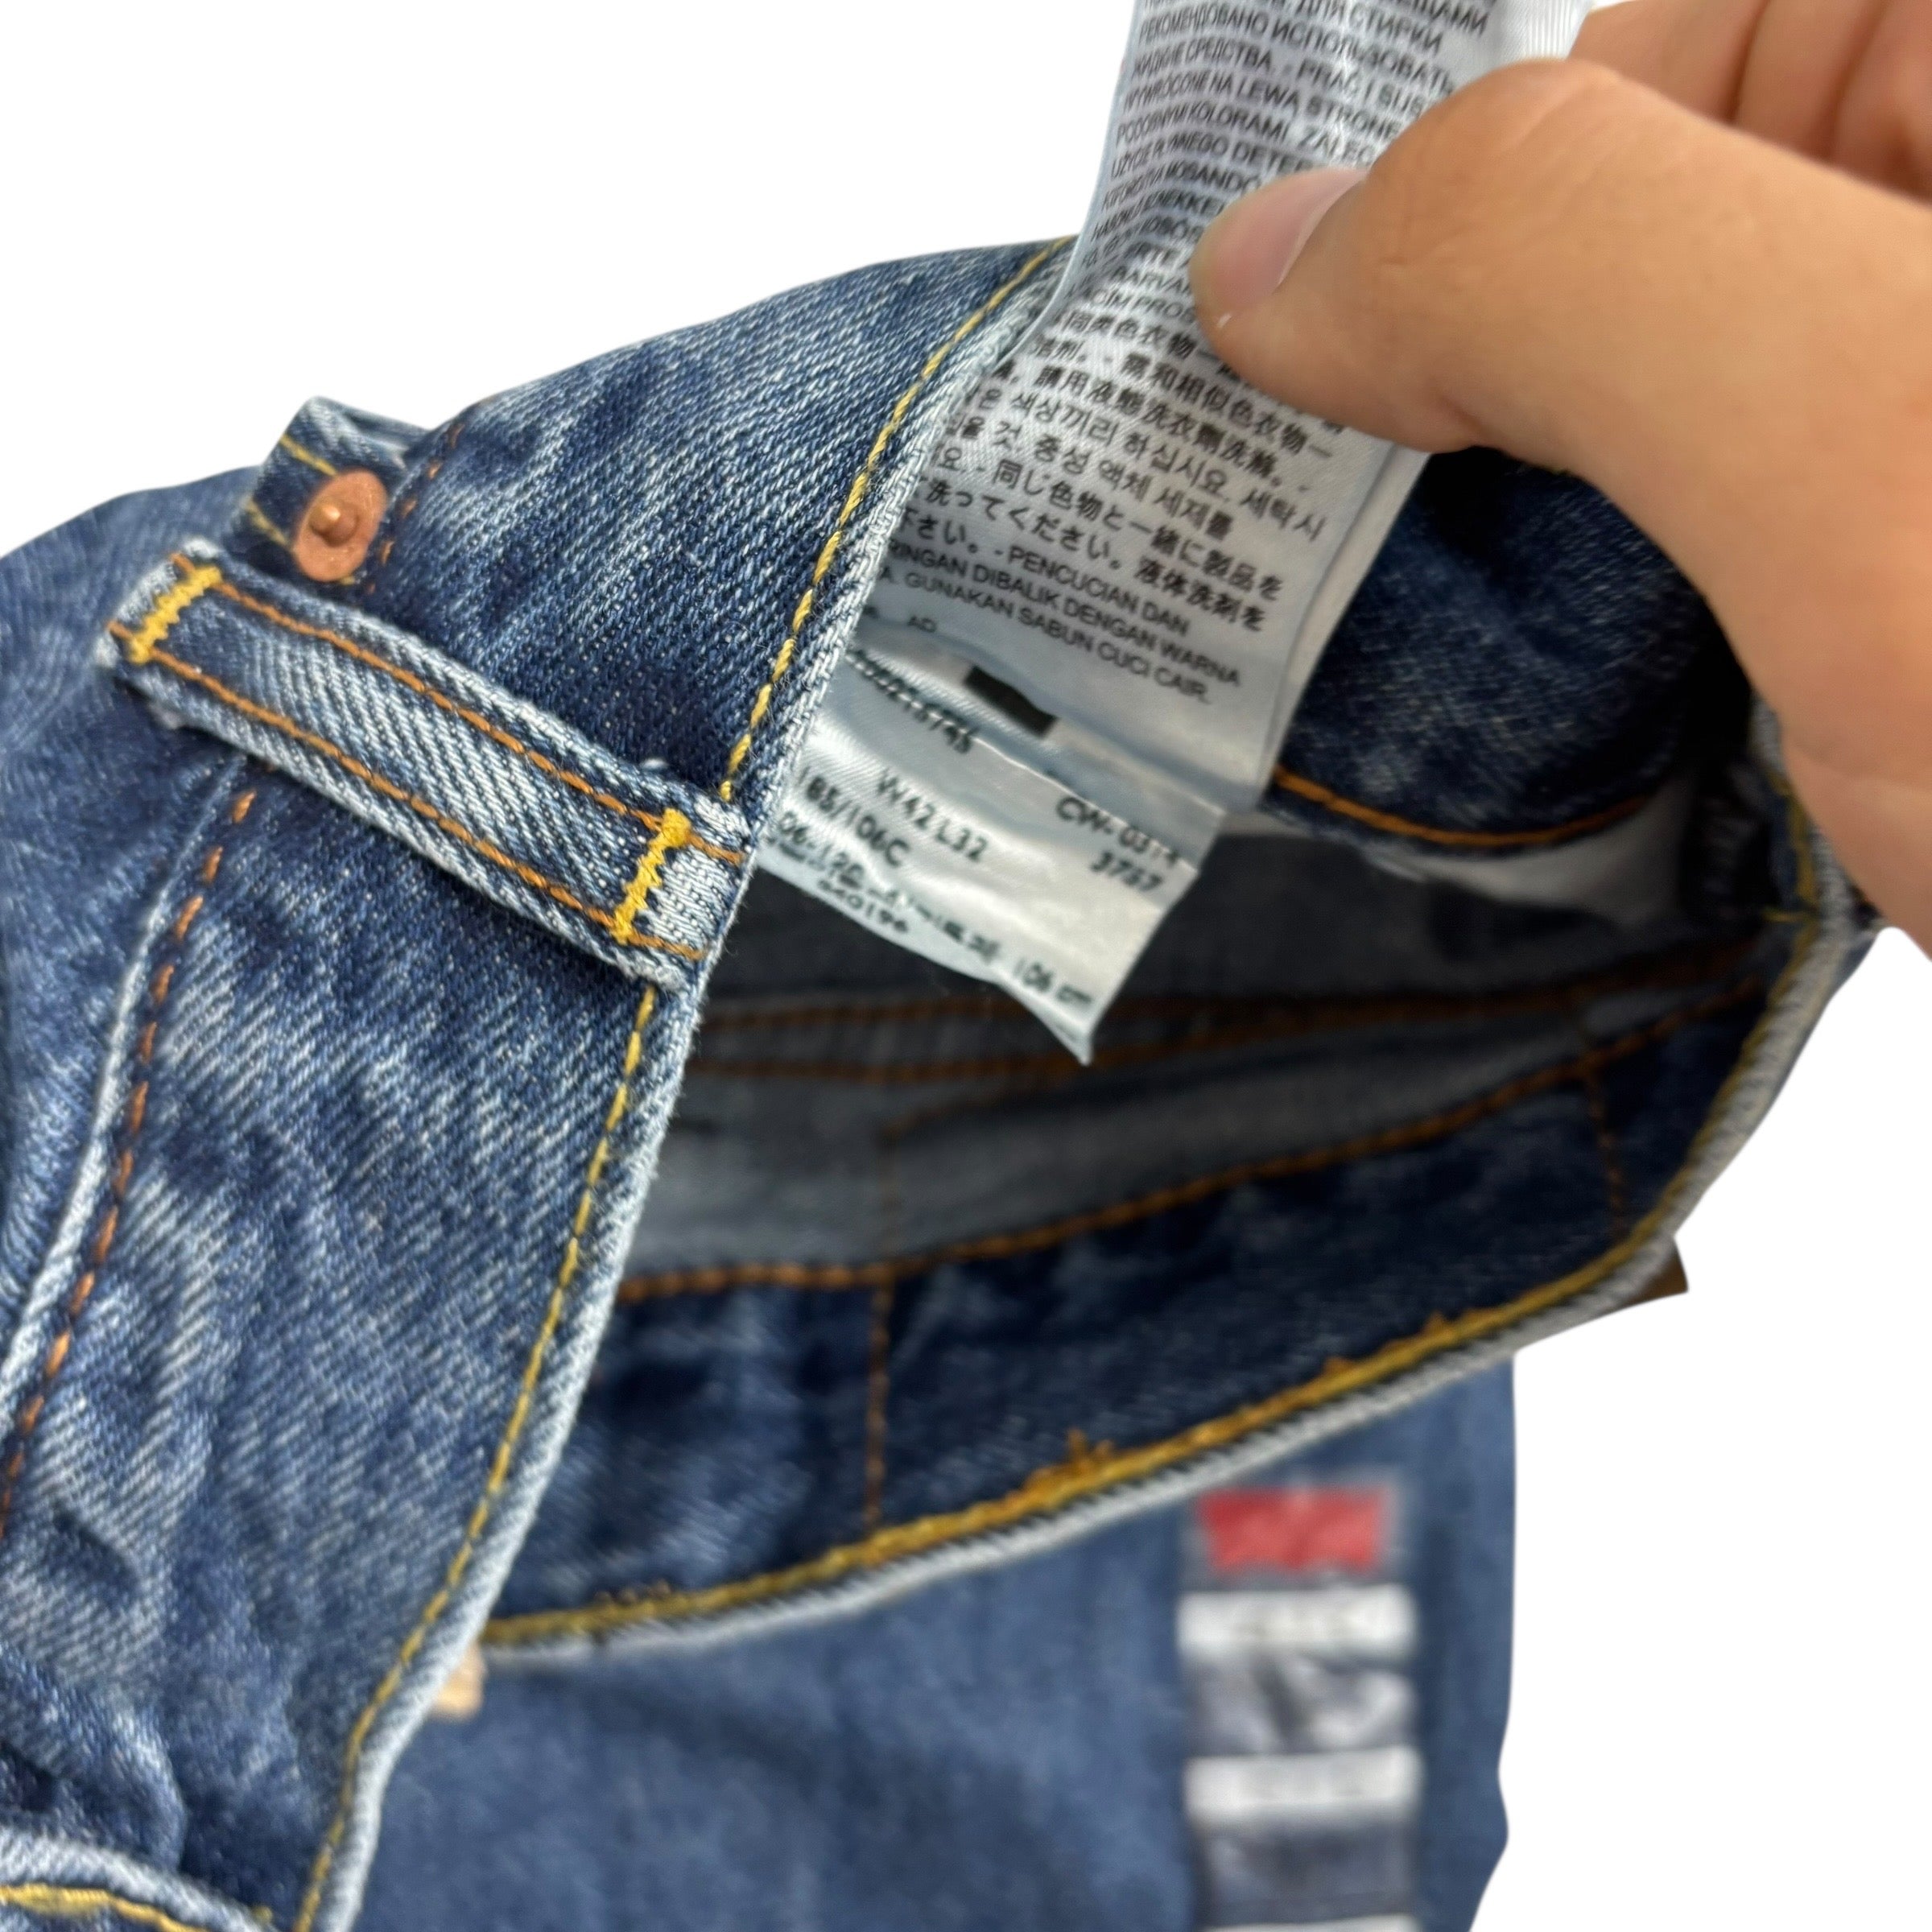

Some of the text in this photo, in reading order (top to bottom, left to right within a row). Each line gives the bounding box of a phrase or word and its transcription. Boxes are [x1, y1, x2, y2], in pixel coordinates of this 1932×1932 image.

[1139, 3, 1269, 43] РЕКОМЕНДОВАНО
[1349, 5, 1443, 58] СТИРКИ
[1011, 391, 1121, 448] 색상끼리
[1240, 488, 1327, 542] 세탁시
[1034, 433, 1092, 477] 중성
[1099, 458, 1153, 503] 액체
[904, 572, 1014, 619] GUNAKAN
[1017, 605, 1092, 654] SABUN
[1096, 642, 1151, 679] CUCI
[972, 564, 1062, 609] DIBALIK
[1062, 597, 1157, 650] DENGAN
[1159, 641, 1241, 687] WARNA
[1009, 543, 1140, 615] PENCUCIAN
[1141, 600, 1191, 638] DAN
